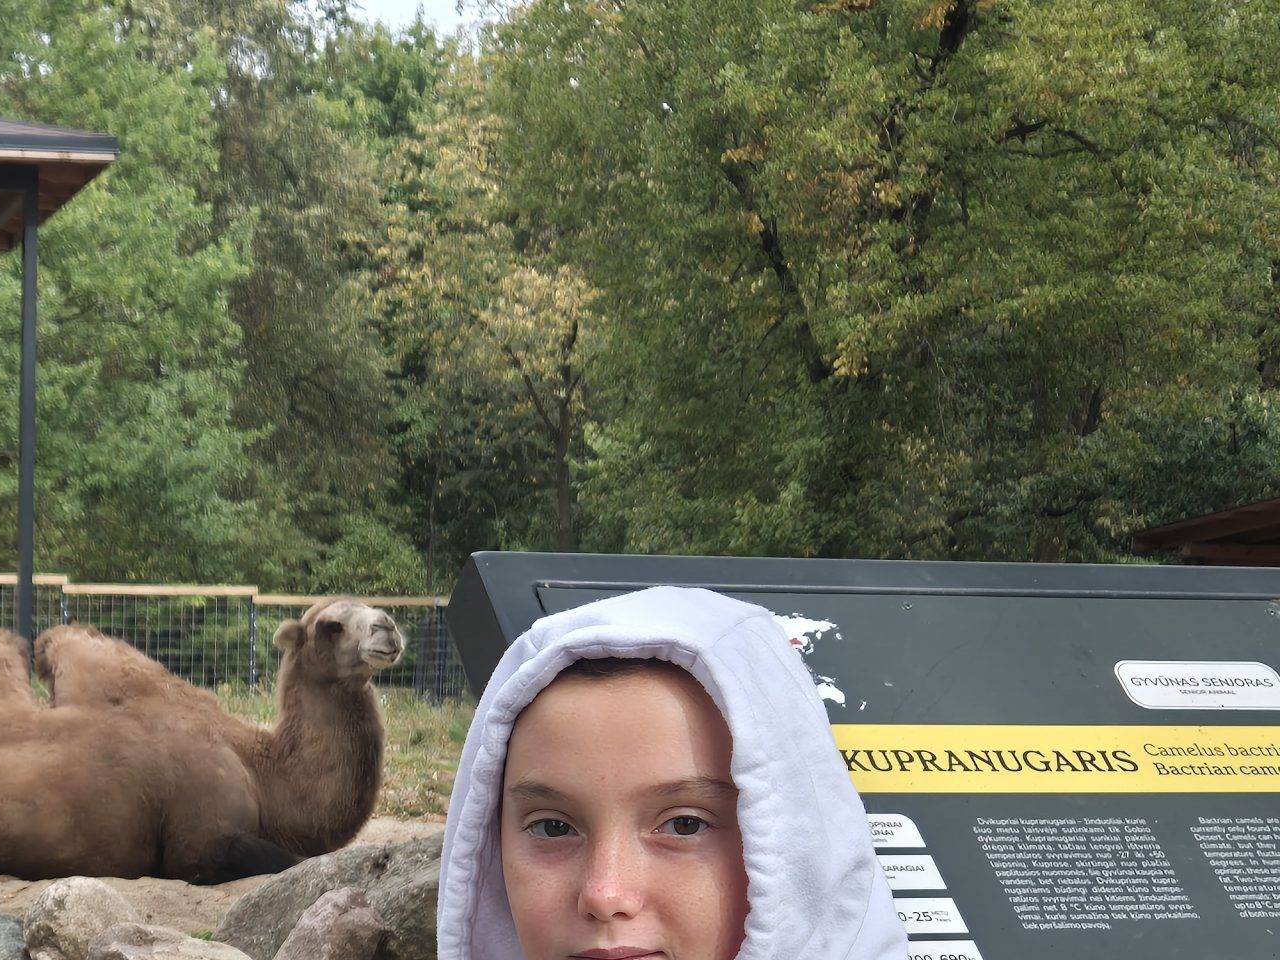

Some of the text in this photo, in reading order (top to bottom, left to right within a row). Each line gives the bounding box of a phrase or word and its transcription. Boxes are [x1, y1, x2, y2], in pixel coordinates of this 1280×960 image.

[1130, 675, 1274, 688] GYVŪNAS SENJORAS
[1143, 743, 1225, 756] Camelus
[841, 749, 1139, 773] KUPRANUGARIS
[1153, 763, 1237, 775] Bactrian
[1062, 826, 1105, 834] sutinkami
